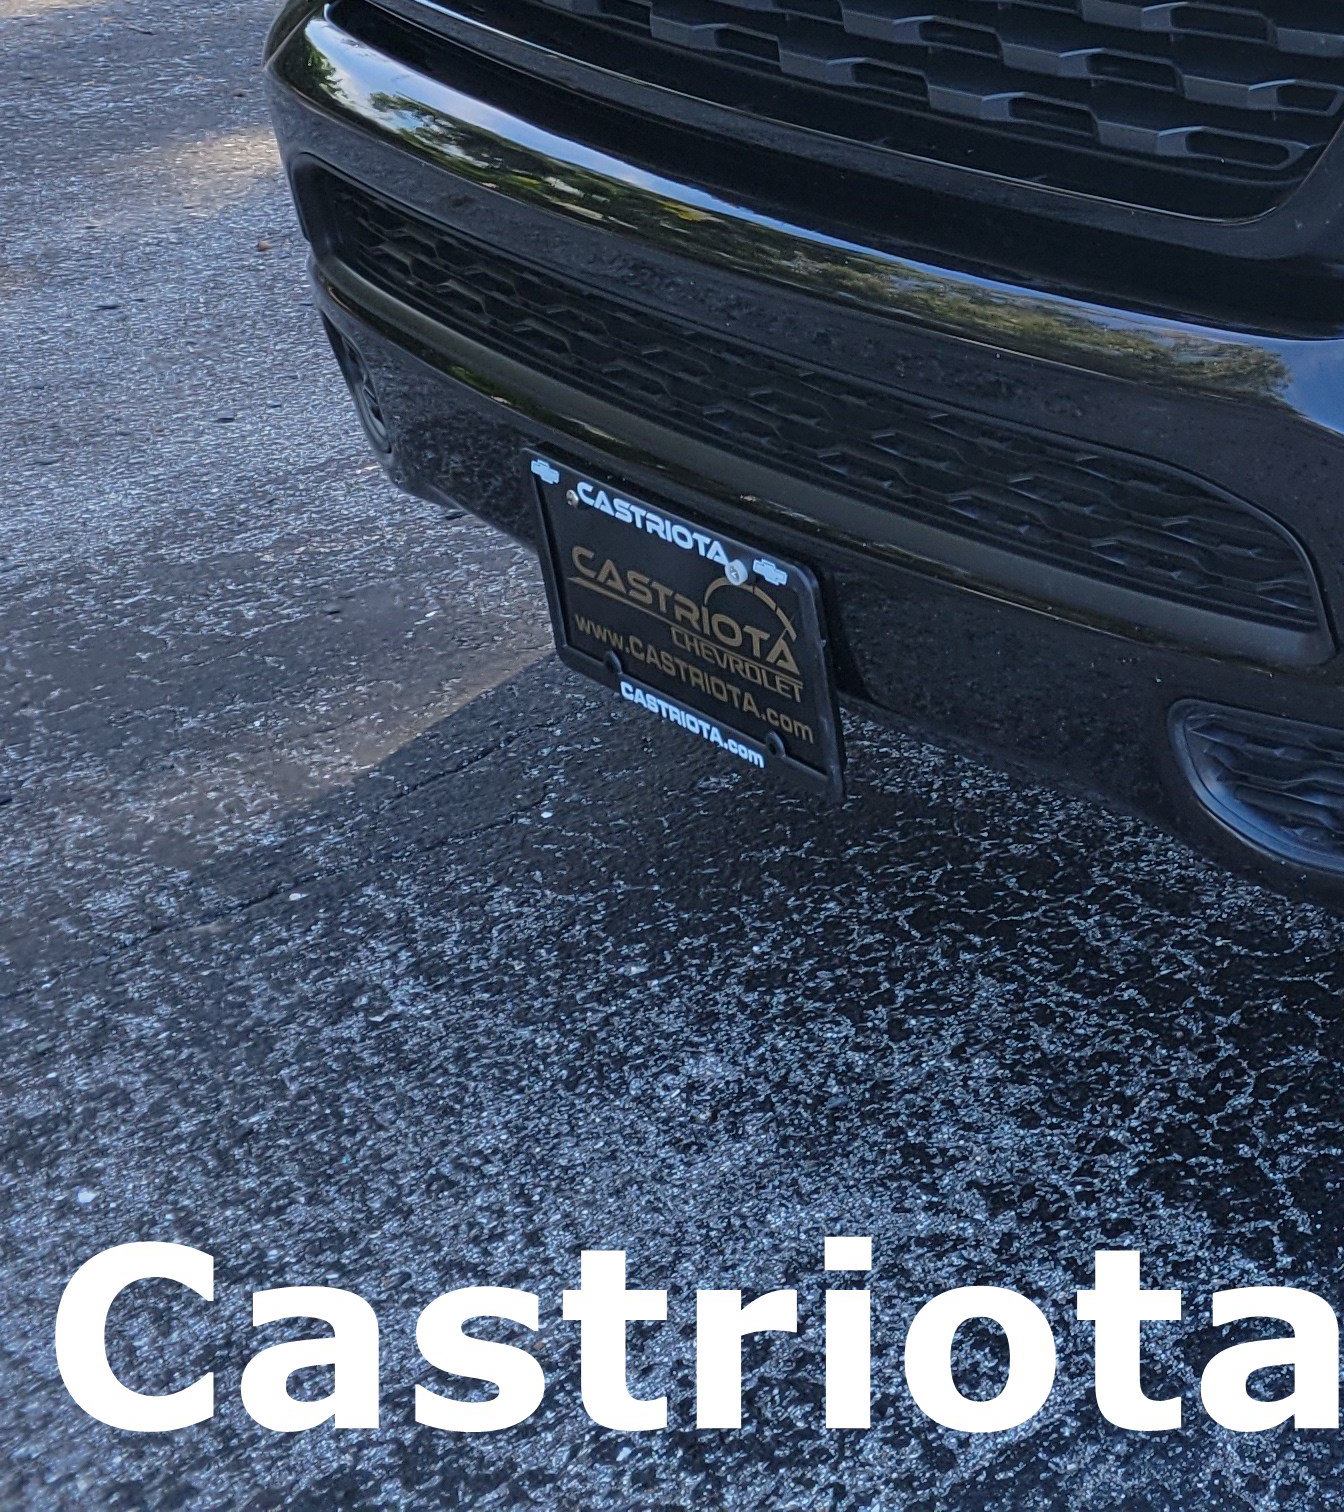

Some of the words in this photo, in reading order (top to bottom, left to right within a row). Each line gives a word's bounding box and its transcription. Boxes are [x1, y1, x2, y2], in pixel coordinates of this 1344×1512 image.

[576, 482, 730, 566] CASTRIOTA
[571, 545, 801, 675] CASTRIOTA
[575, 614, 815, 744] www.CASTRIOTA.com
[670, 626, 804, 704] CHEVROLET
[620, 681, 766, 769] CASTRIOTA.com
